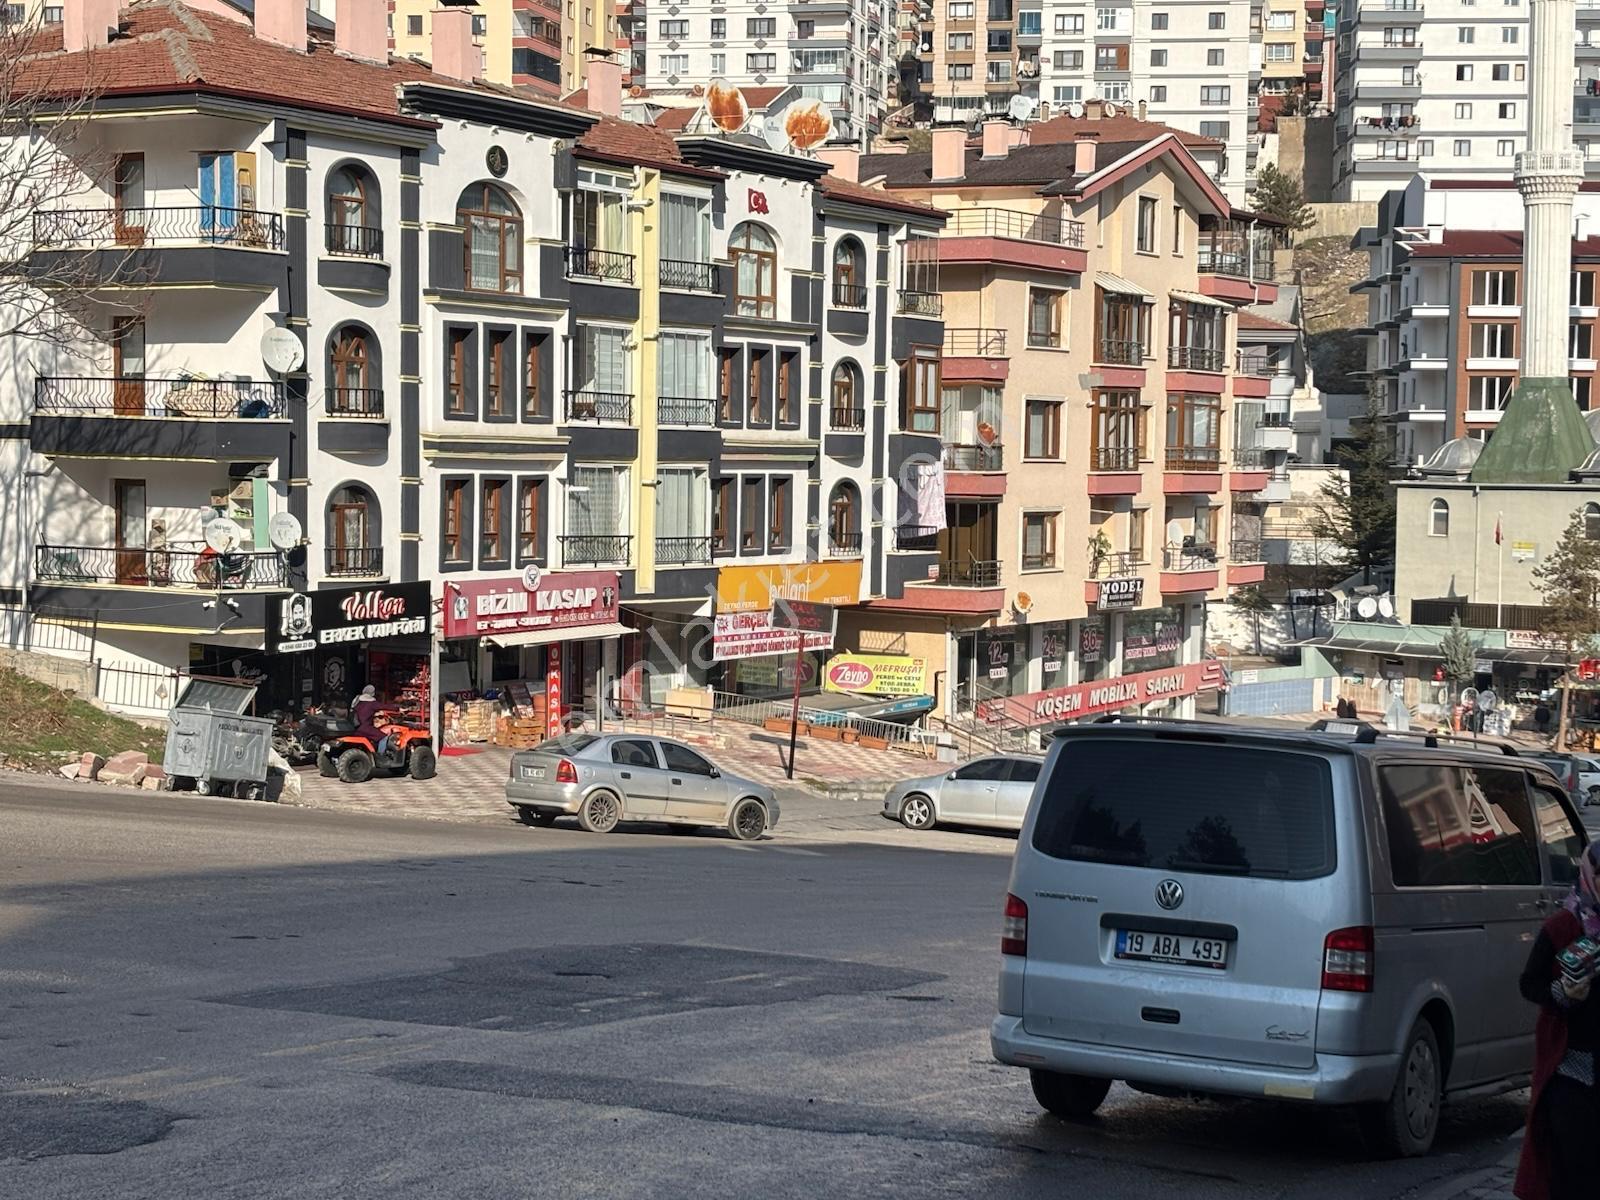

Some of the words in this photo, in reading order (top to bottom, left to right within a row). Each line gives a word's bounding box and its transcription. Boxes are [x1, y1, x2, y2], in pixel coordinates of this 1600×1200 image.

[769, 567, 811, 606] brillant
[1101, 580, 1143, 594] MODEL
[341, 590, 405, 620] Volkan
[536, 587, 598, 612] KASAP
[732, 612, 769, 631] GERÇEK
[320, 625, 366, 644] ERKEK
[1043, 635, 1056, 657] 24
[1083, 628, 1096, 651] 36
[988, 641, 1002, 664] 12
[836, 666, 869, 684] Zeyno
[873, 664, 923, 674] MEFRUŞAT
[550, 670, 559, 736] KASAP
[1035, 692, 1082, 719] KÖŞEM
[1088, 680, 1138, 708] MOBİLYA
[1146, 673, 1185, 696] SARAYI
[1127, 933, 1144, 953] 19
[1152, 936, 1181, 957] ABA
[1192, 939, 1223, 961] 493
